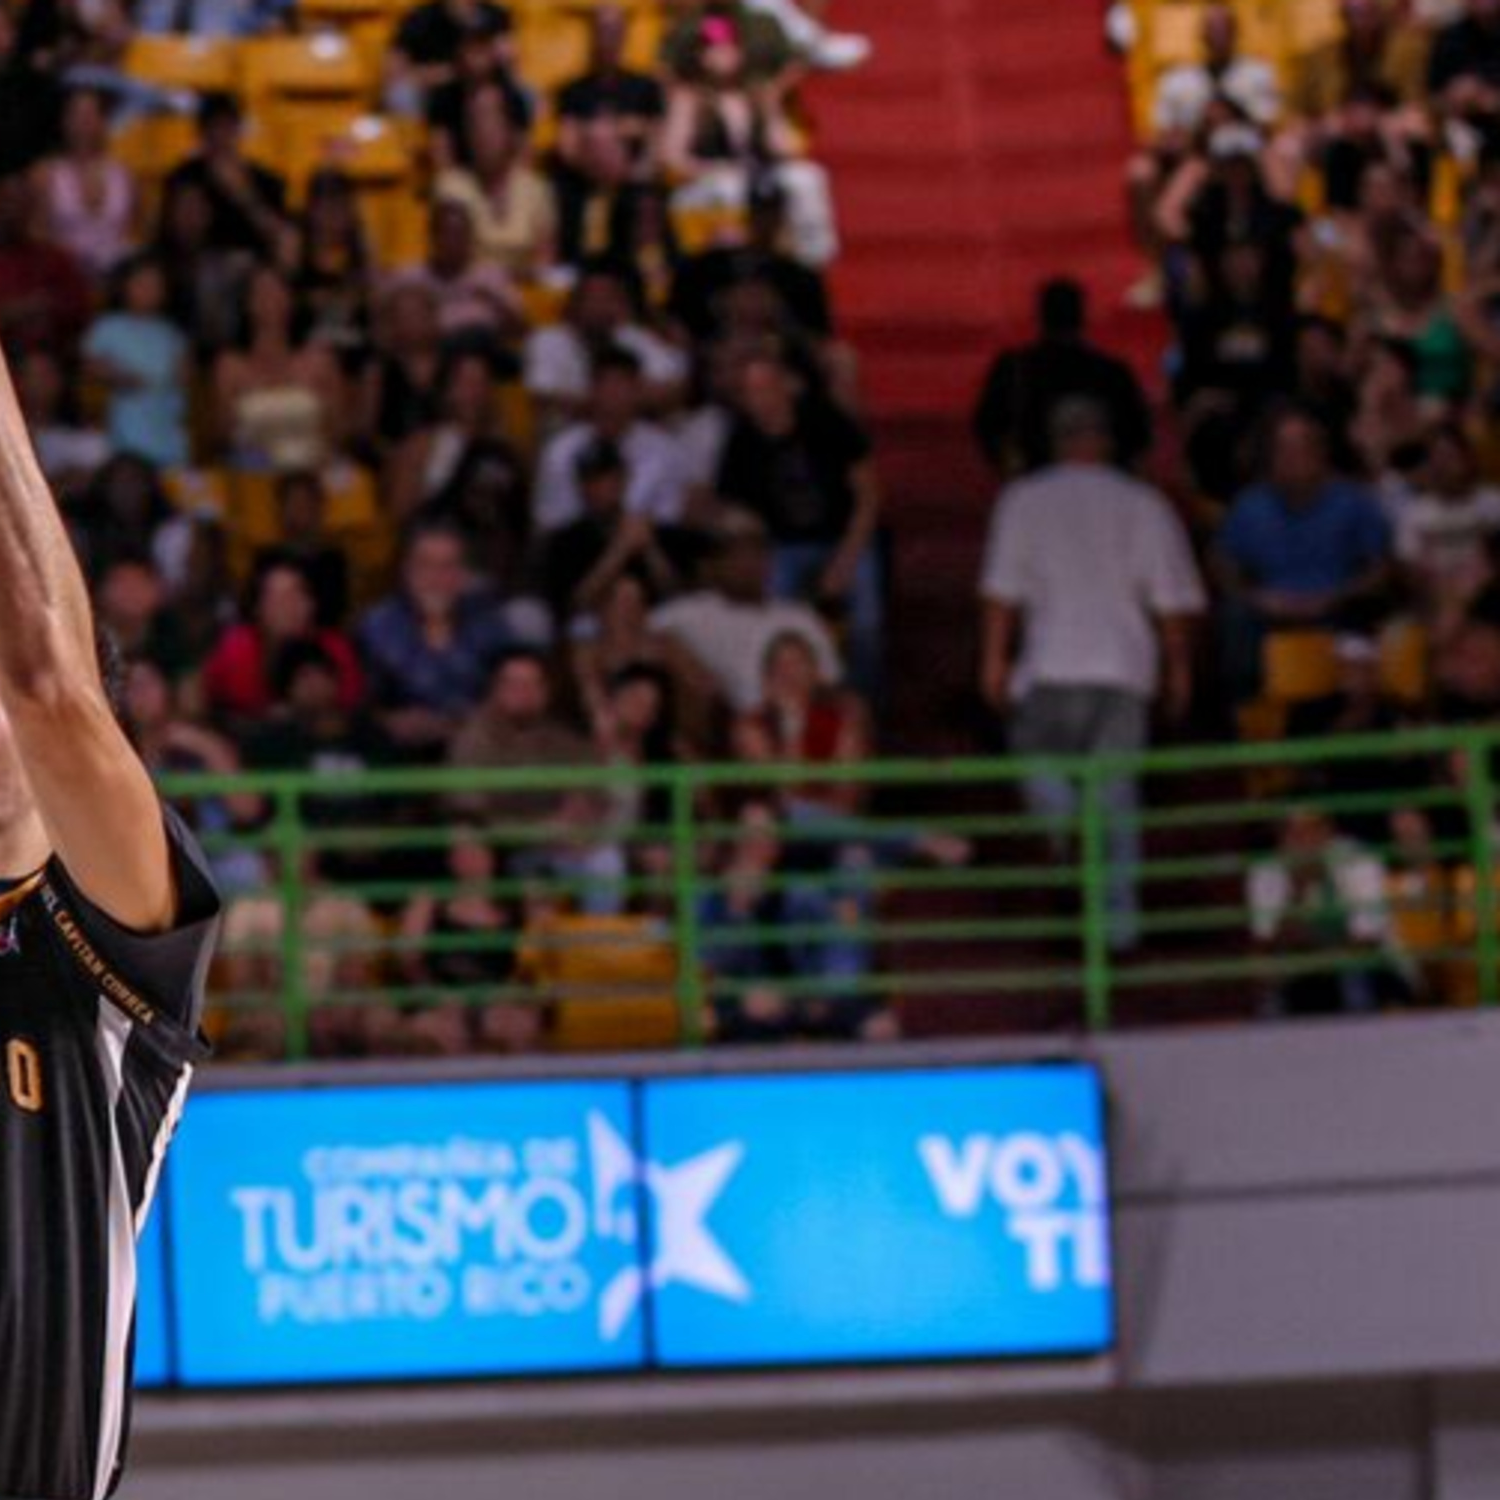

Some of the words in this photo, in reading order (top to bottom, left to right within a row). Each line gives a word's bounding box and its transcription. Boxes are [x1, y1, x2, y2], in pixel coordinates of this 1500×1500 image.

[232, 1177, 586, 1272] TURISMO
[258, 1266, 452, 1325] PUERTO
[461, 1261, 589, 1316] RICO
